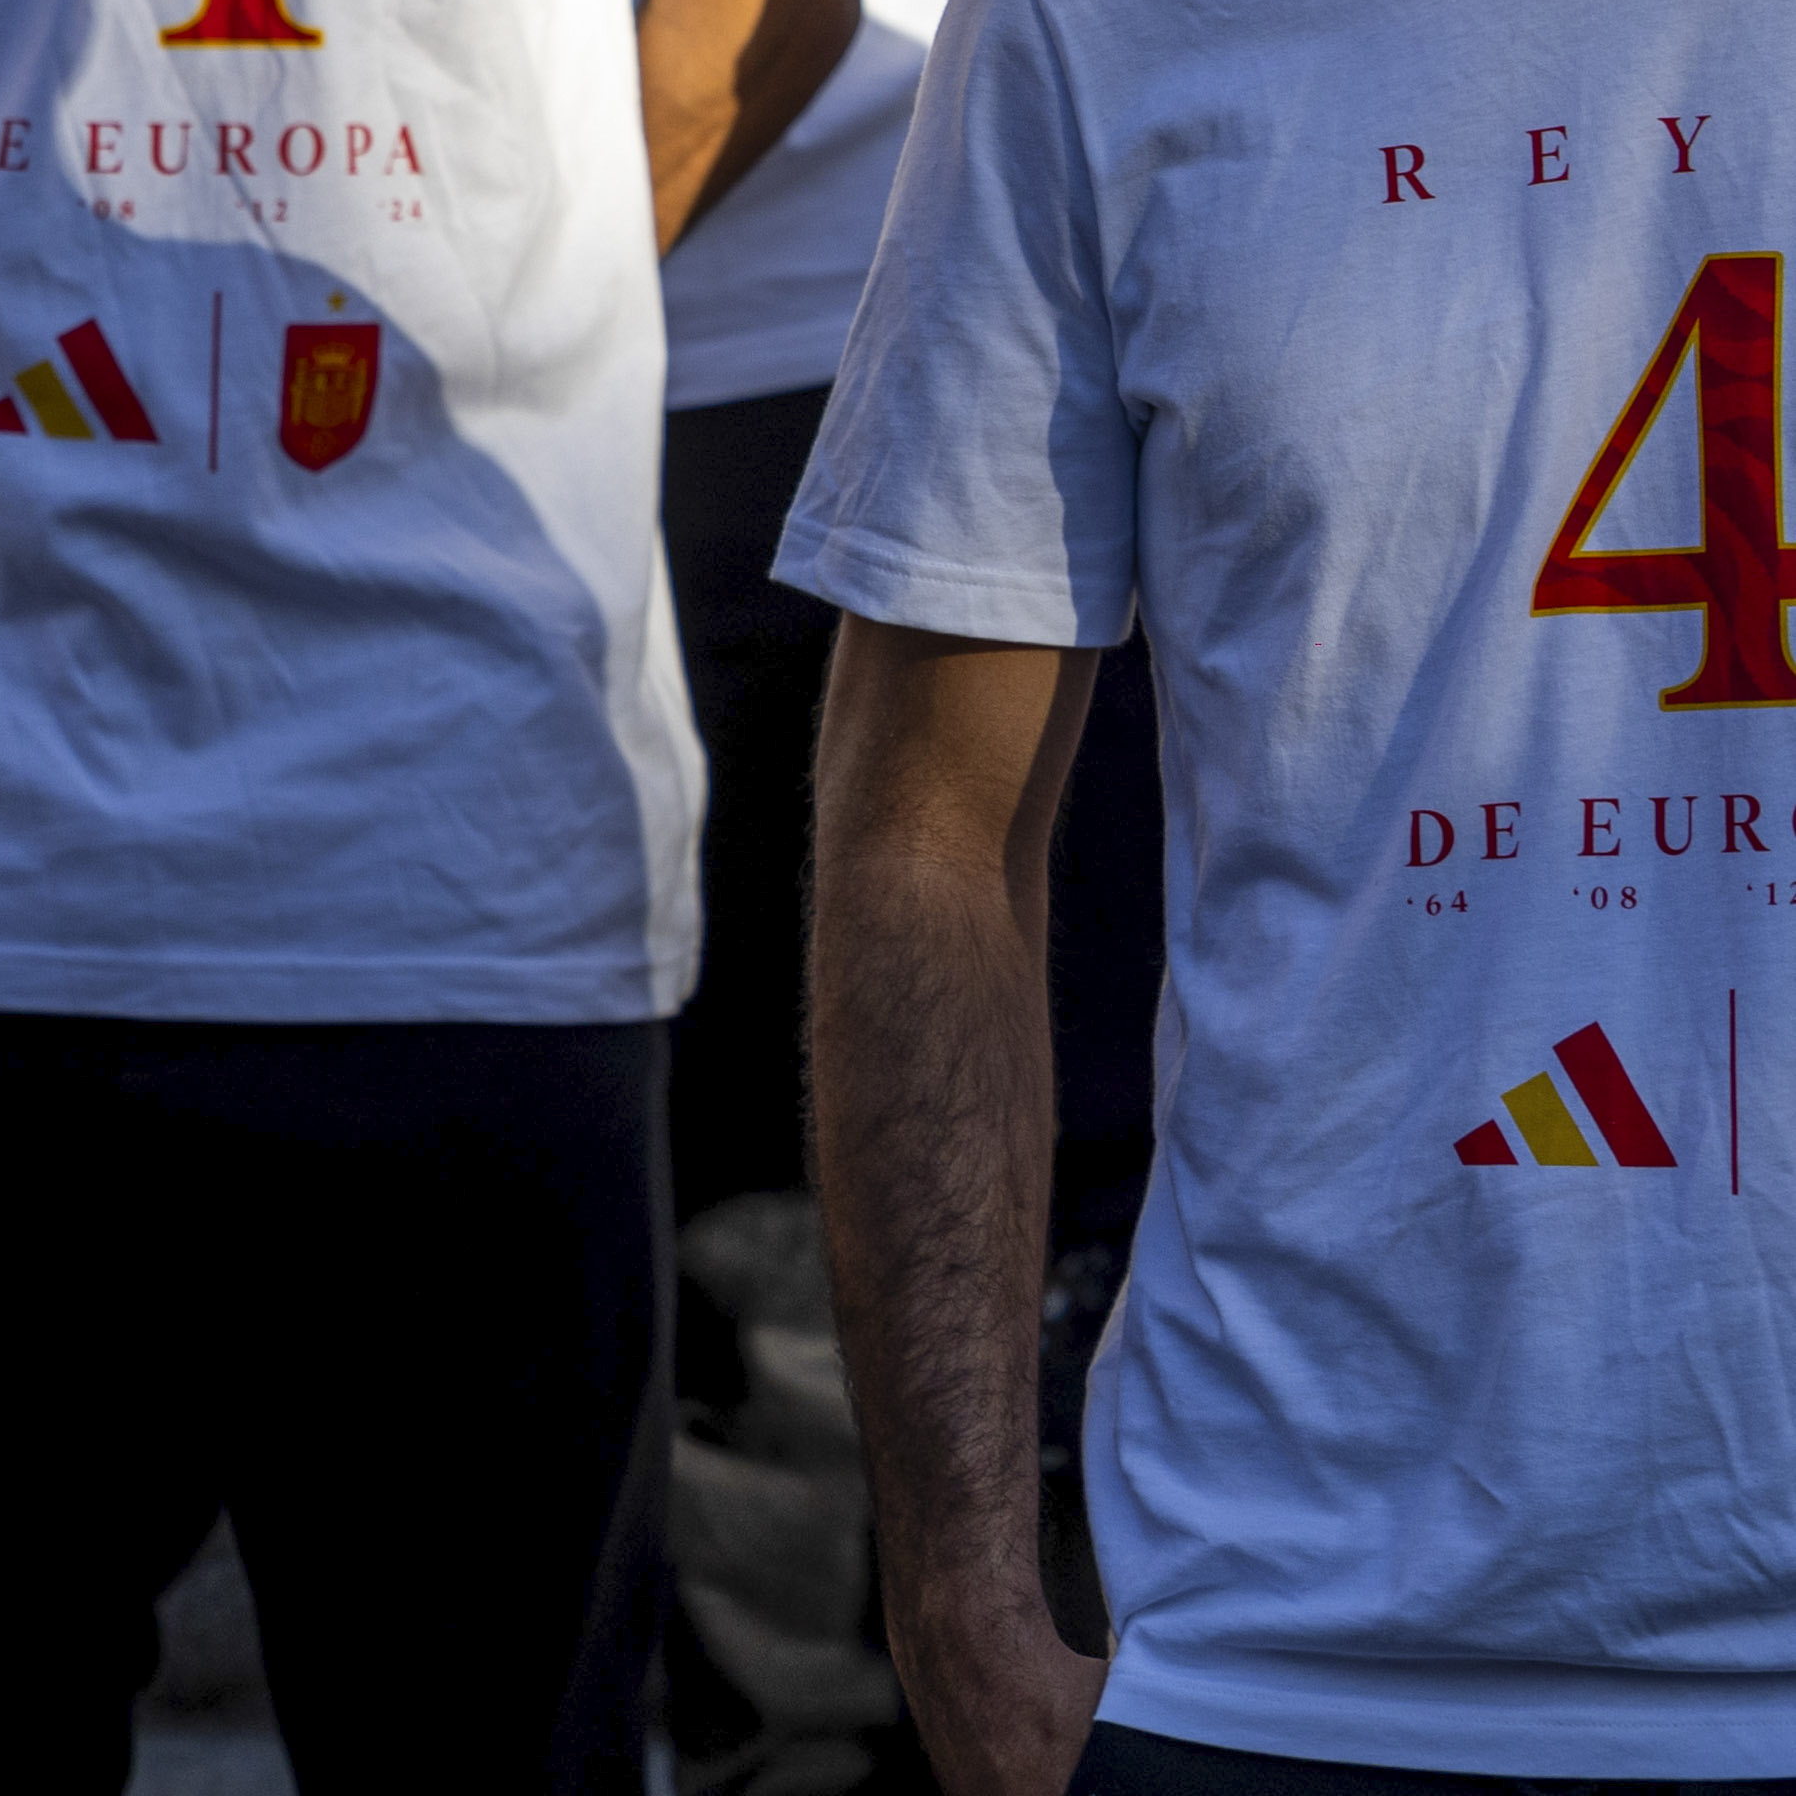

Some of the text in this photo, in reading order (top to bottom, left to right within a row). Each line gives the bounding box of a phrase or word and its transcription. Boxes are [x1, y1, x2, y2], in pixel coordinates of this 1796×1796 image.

[85, 120, 424, 177] EUROPA
[1529, 250, 1796, 710] 4
[1405, 793, 1796, 868] DE EUR
